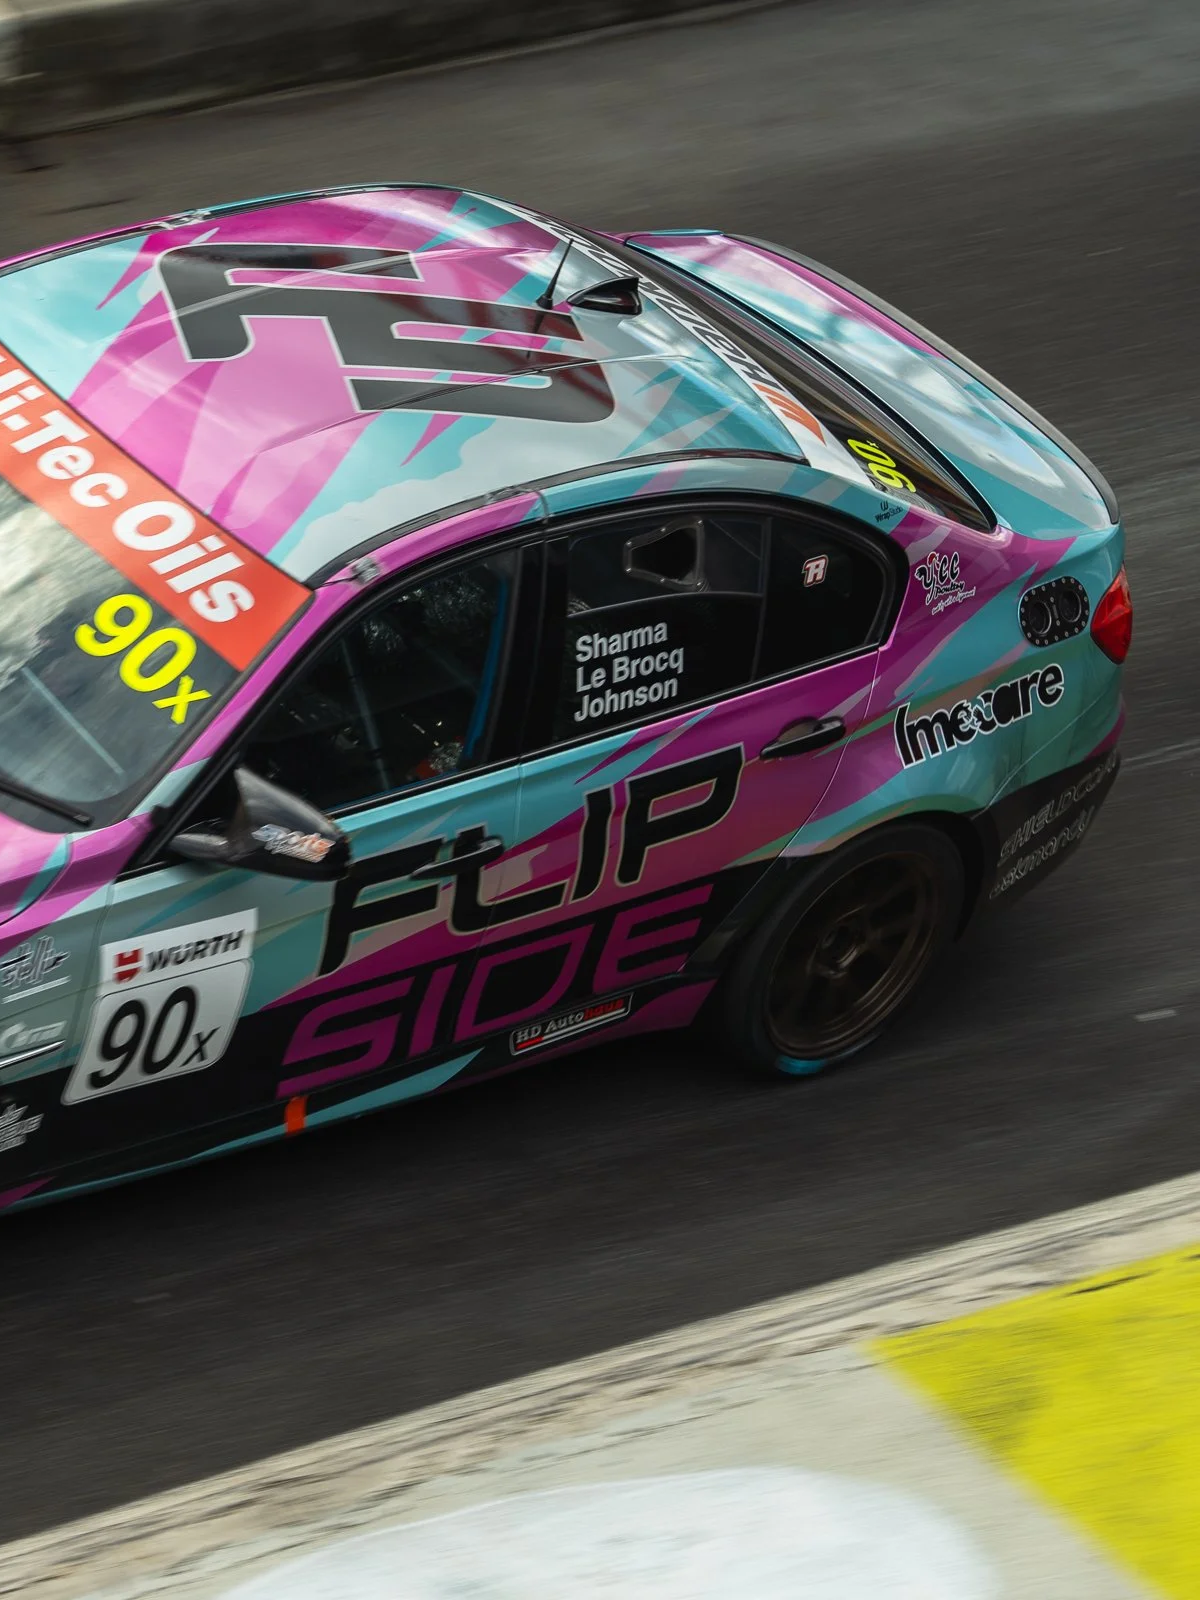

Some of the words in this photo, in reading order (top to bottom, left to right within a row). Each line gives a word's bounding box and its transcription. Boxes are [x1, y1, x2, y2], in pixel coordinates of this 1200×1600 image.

[112, 500, 255, 623] Oils
[575, 622, 668, 662] Sharma
[576, 666, 606, 693] Le
[613, 647, 684, 684] Brocq
[574, 677, 679, 722] Johnson
[316, 742, 745, 978] FLIP
[276, 884, 714, 1099] SIDE
[516, 1024, 542, 1043] HD
